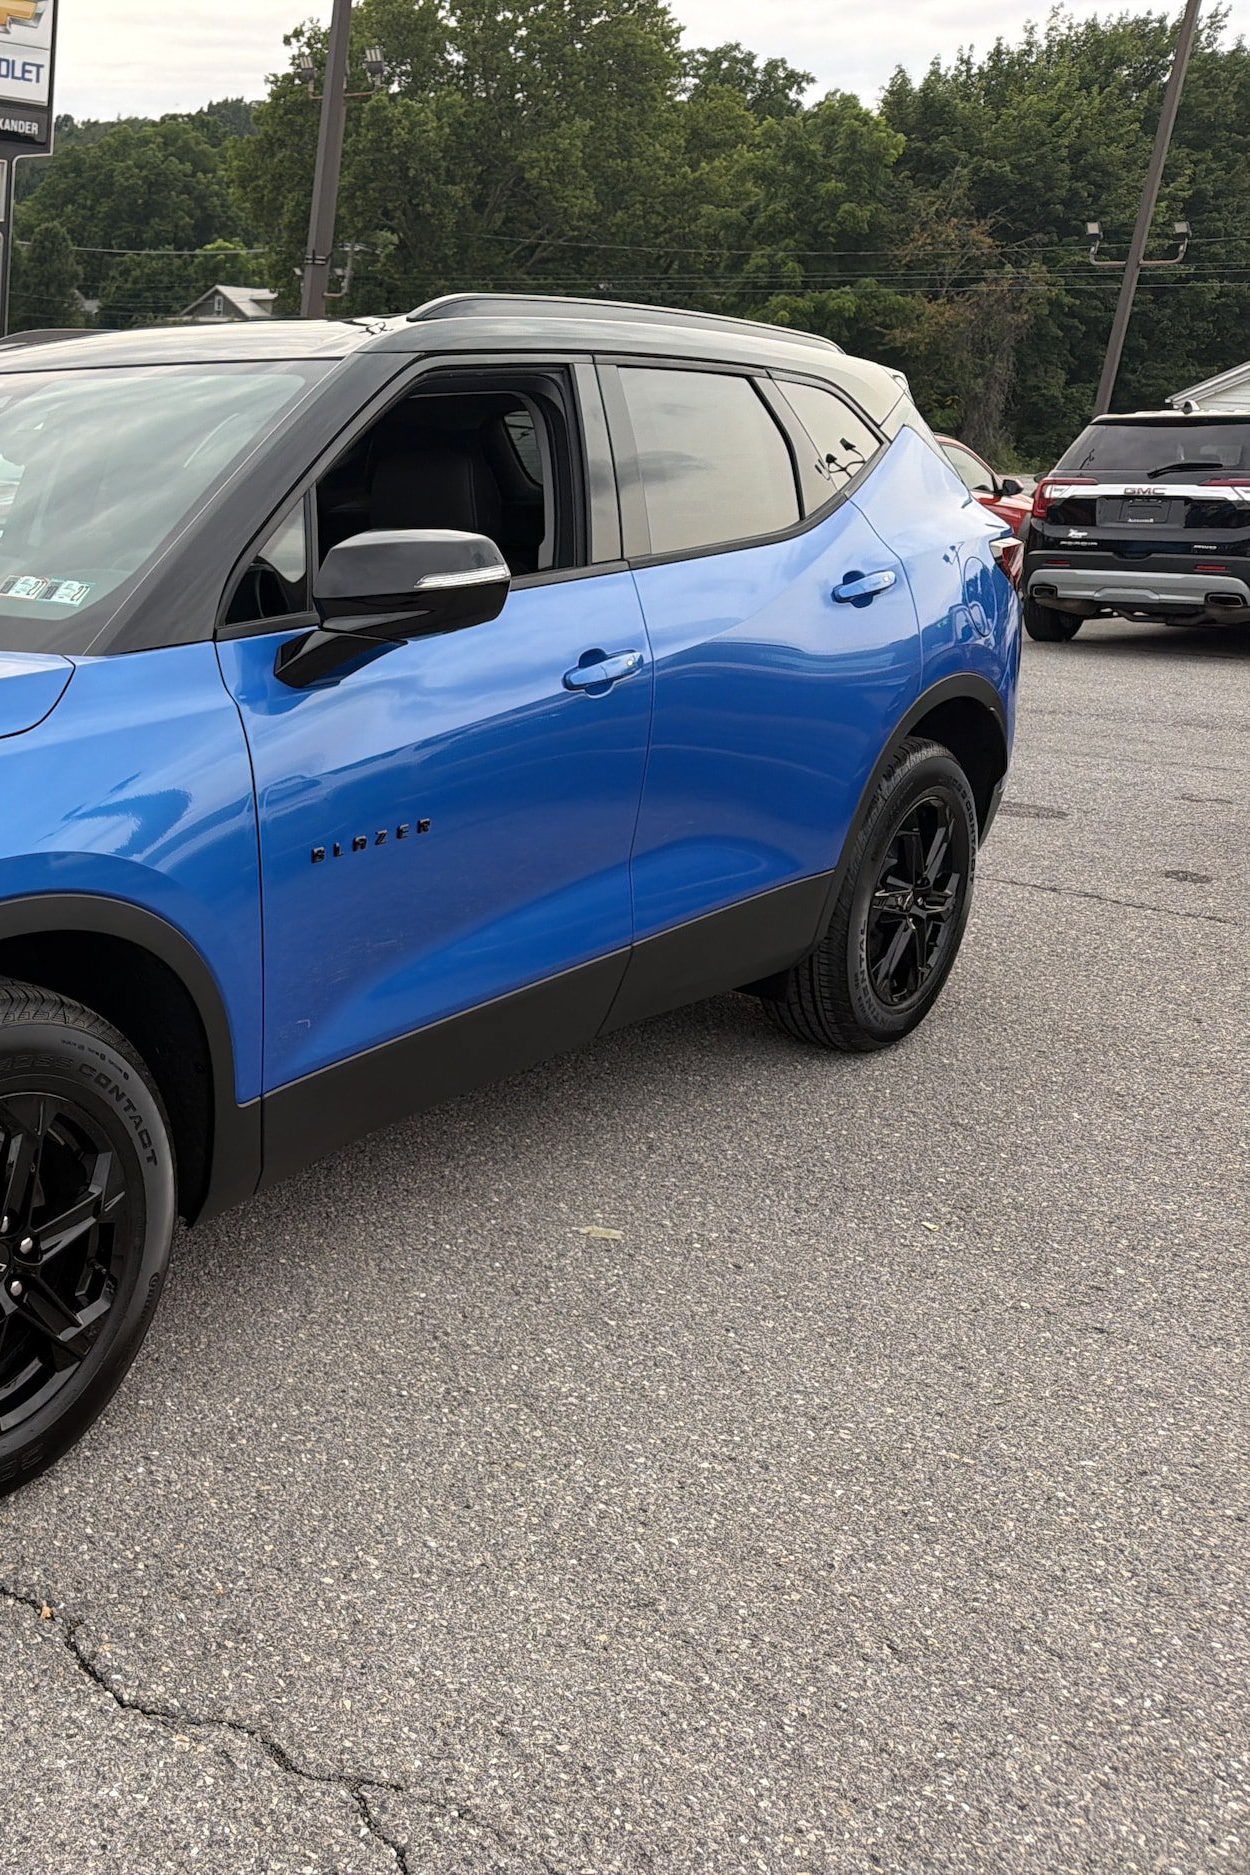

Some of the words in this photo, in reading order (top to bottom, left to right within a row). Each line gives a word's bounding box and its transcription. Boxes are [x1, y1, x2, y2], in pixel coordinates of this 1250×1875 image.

[1124, 487, 1167, 495] GMC
[311, 818, 430, 864] BLAZER
[79, 1062, 158, 1166] CONTACT
